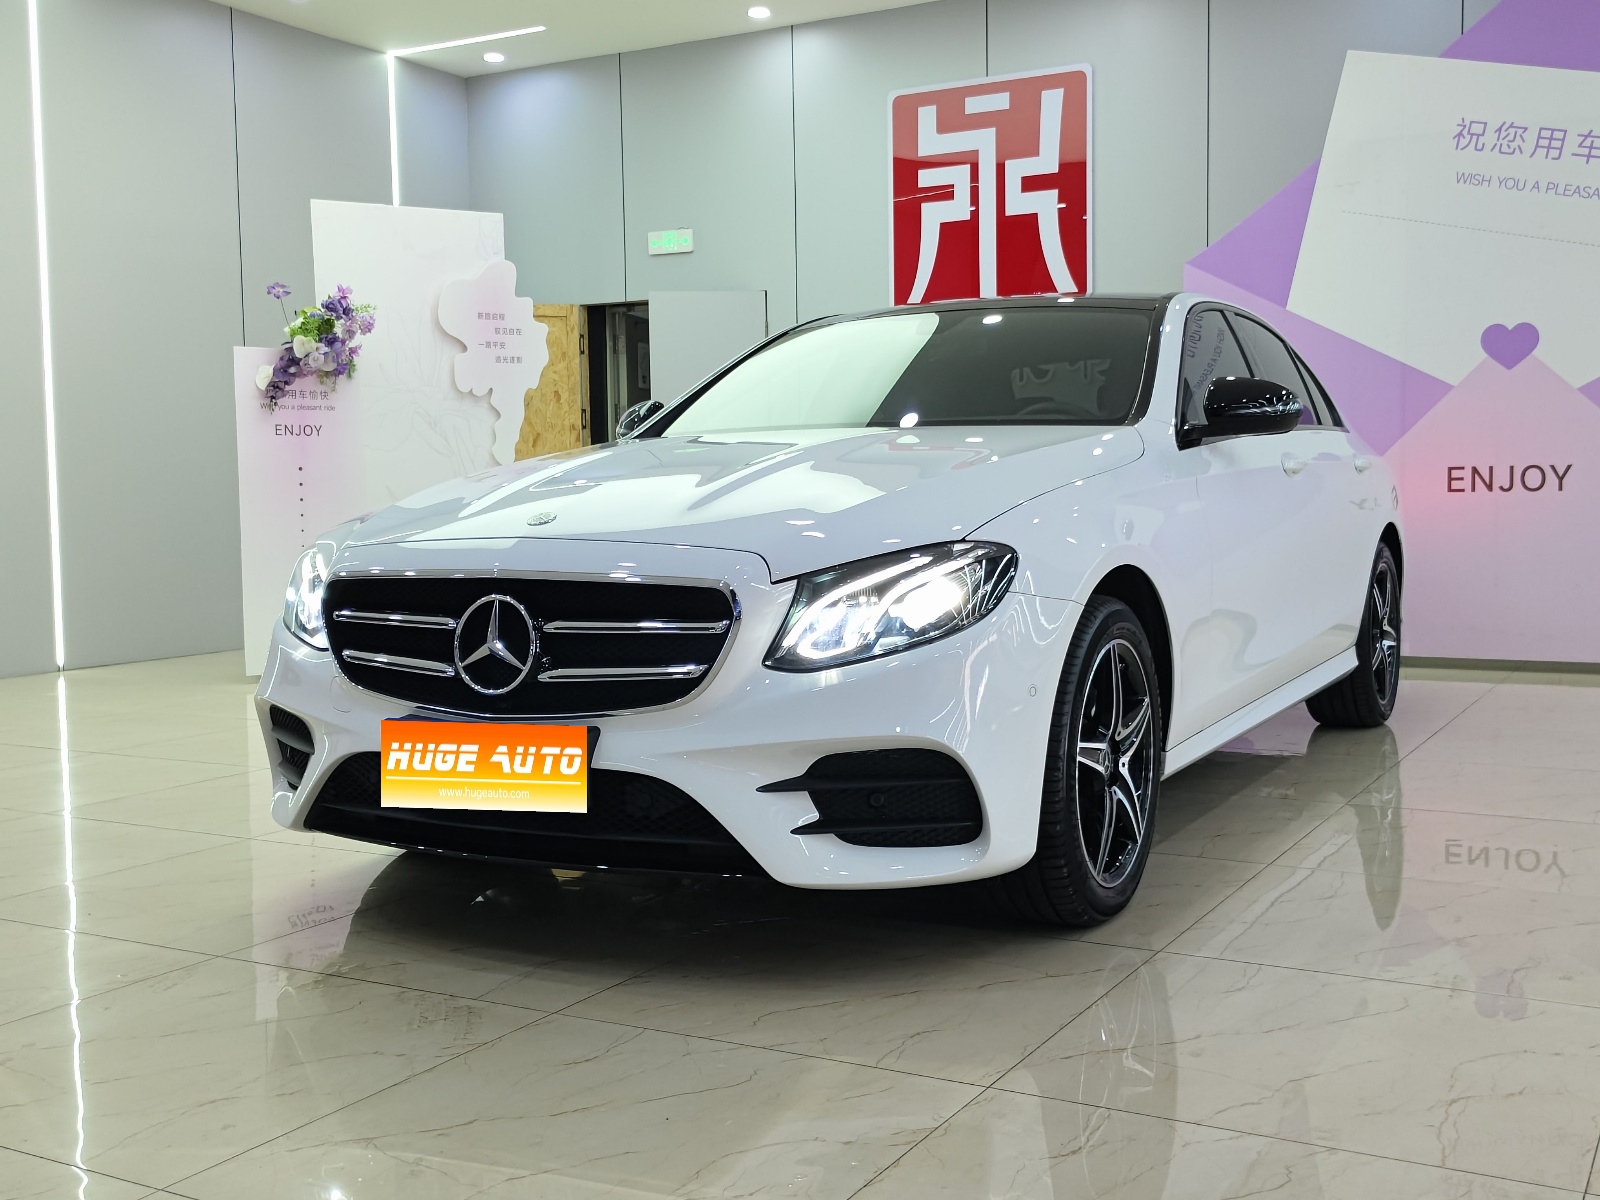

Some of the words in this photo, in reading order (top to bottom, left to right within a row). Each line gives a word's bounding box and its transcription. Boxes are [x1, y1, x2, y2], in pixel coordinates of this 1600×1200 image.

[1452, 117, 1600, 164] 祝您用车
[1456, 171, 1492, 188] WISH
[1497, 176, 1526, 192] YOU
[1530, 180, 1540, 193] A
[478, 341, 506, 350] 一路平安
[296, 404, 322, 412] pleasant
[275, 424, 322, 437] ENJOY
[1446, 463, 1573, 493] ENJOY
